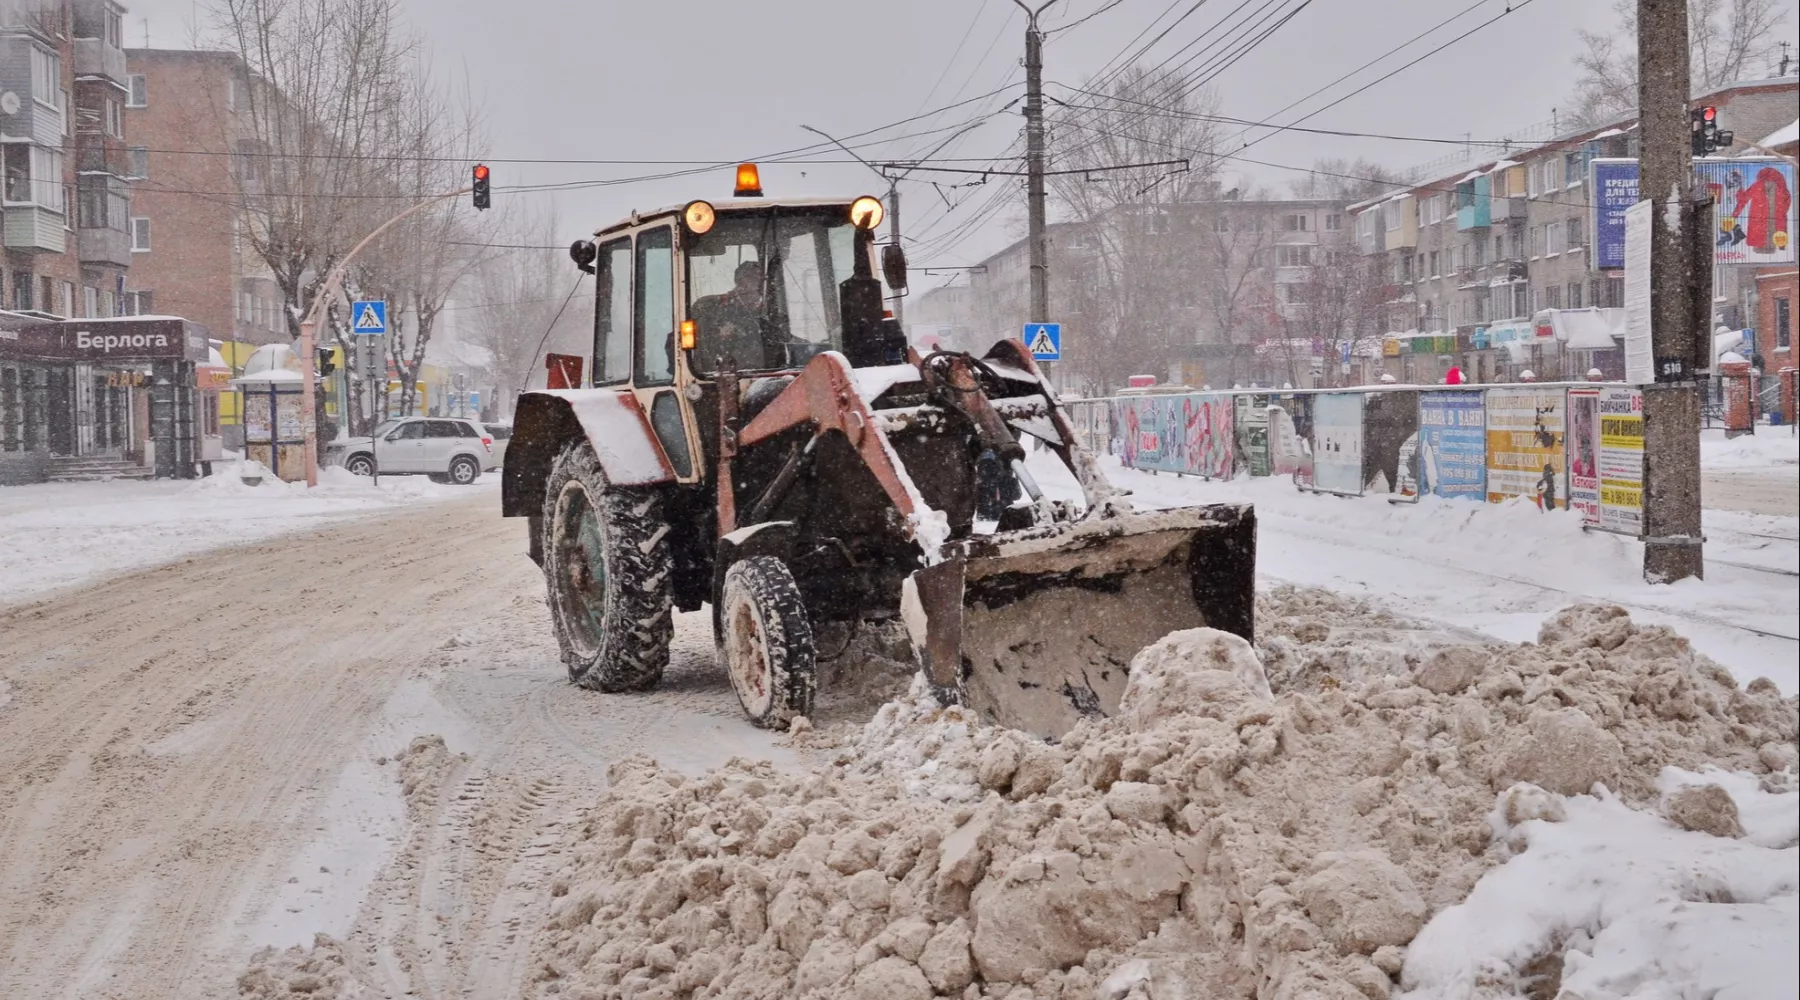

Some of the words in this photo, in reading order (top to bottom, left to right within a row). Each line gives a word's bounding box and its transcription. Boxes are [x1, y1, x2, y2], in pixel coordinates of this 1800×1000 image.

[1605, 179, 1639, 187] КРЕДИТ
[1605, 188, 1625, 197] ДЛЯ
[76, 331, 168, 352] Берлога
